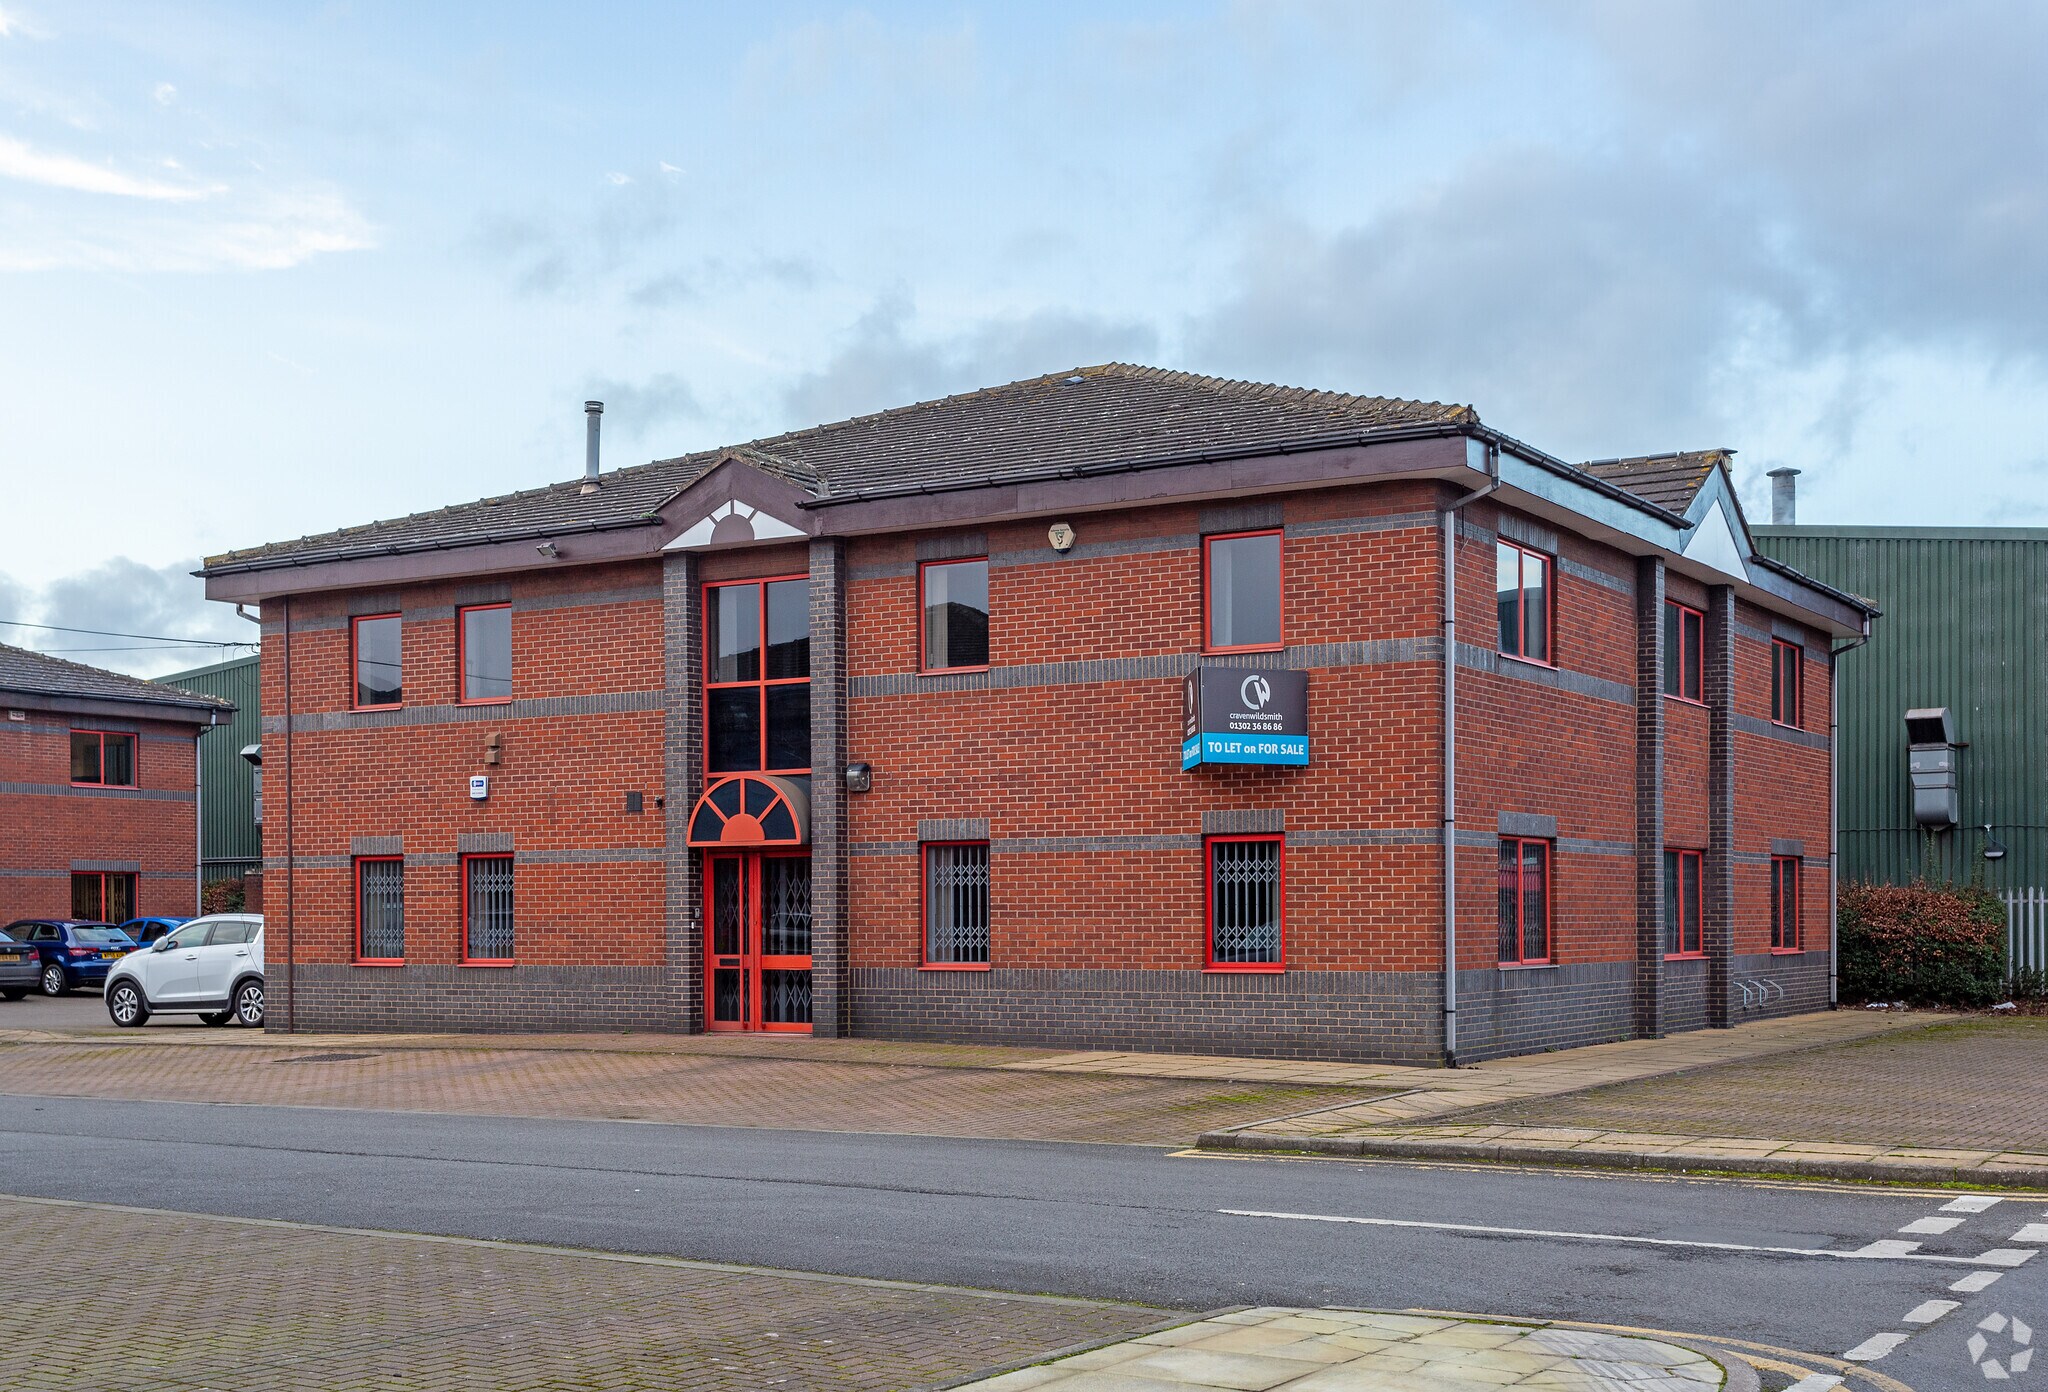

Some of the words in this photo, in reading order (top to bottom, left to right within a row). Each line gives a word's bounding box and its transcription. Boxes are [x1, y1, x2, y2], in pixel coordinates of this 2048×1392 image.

[1230, 712, 1282, 720] cravenwildsmith
[1230, 722, 1251, 730] 01302
[1252, 722, 1262, 731] 36
[1262, 722, 1272, 731] 86
[1273, 722, 1283, 731] 86
[1208, 741, 1222, 753] TO
[1224, 742, 1242, 754] LET
[1258, 743, 1278, 755] FOR
[1280, 744, 1304, 755] SALE
